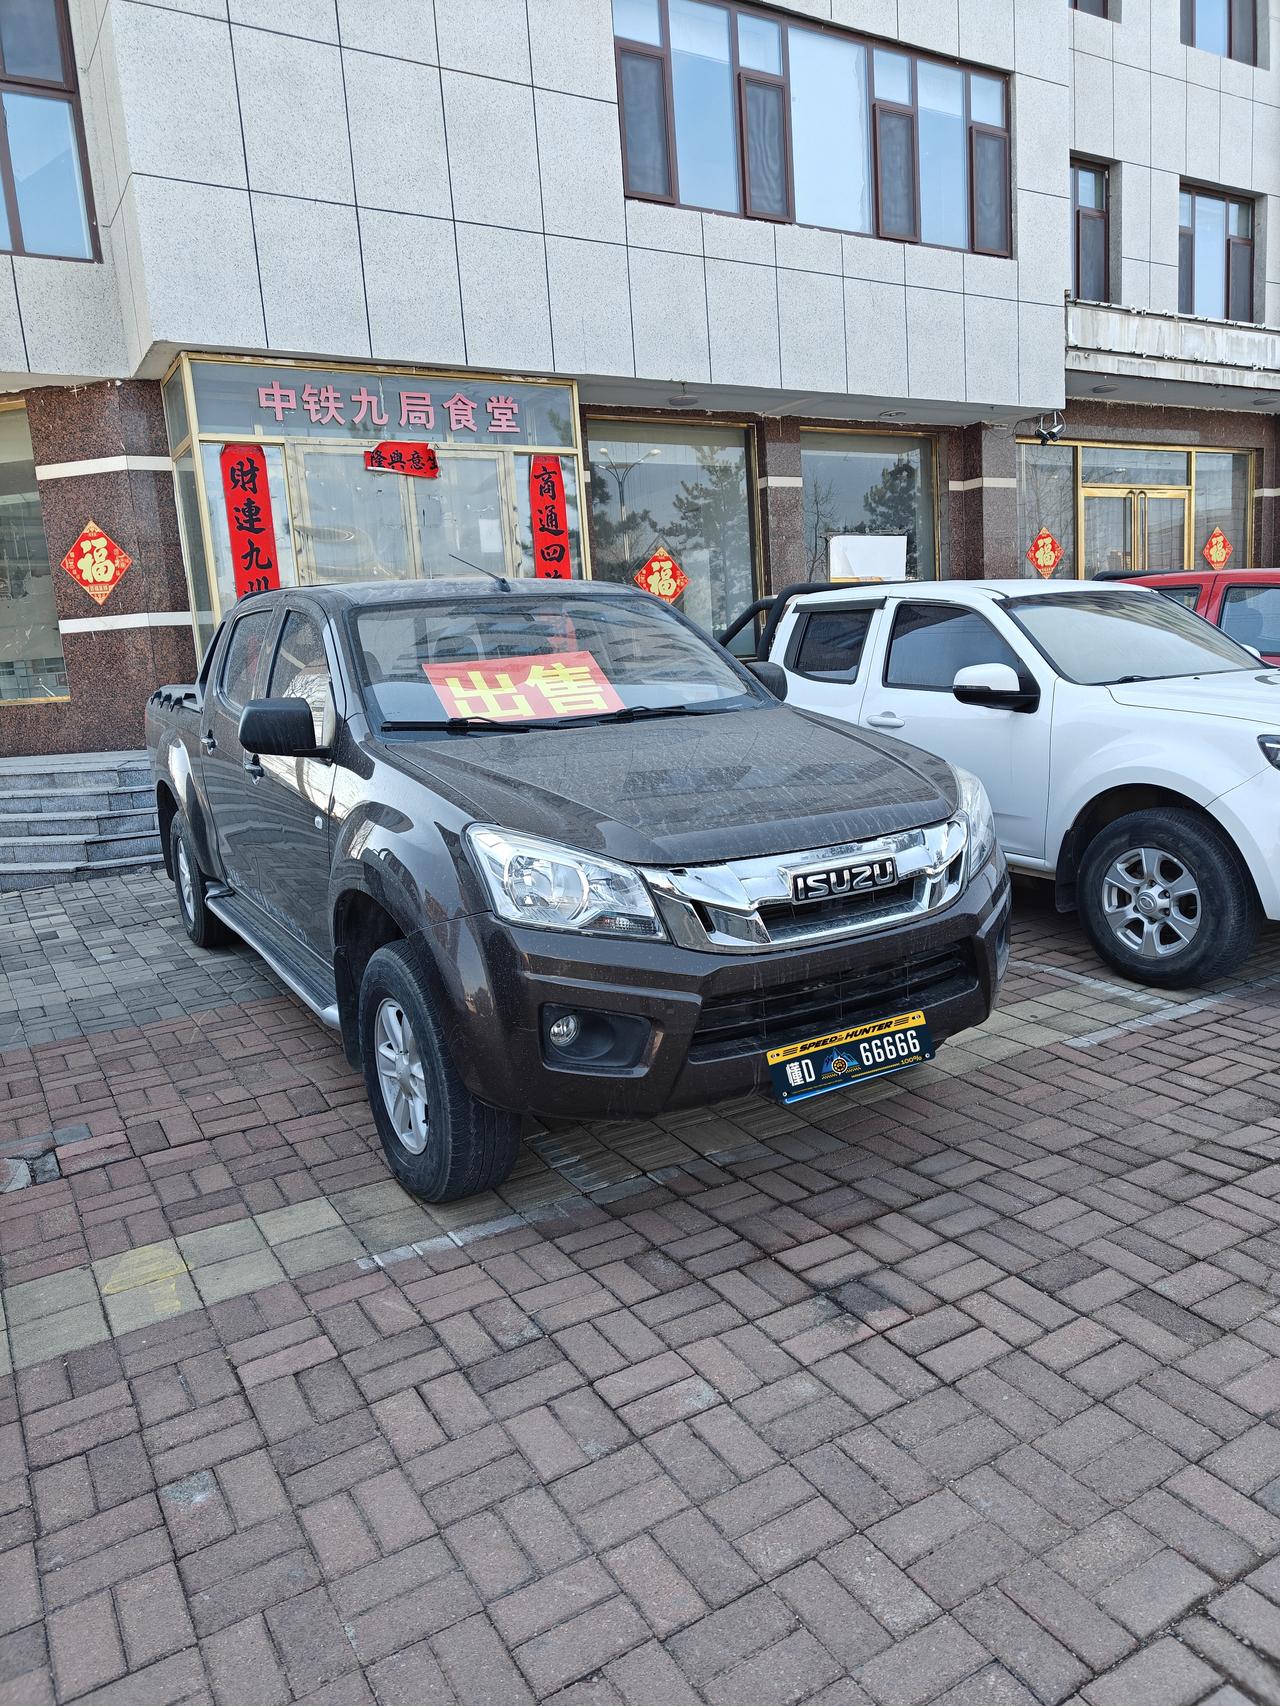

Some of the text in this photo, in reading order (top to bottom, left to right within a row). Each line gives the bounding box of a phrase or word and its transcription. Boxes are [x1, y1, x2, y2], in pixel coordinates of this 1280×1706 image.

[258, 380, 521, 433] 中铁九局食堂
[534, 466, 566, 578] 商通四
[77, 537, 115, 583] 福
[1036, 537, 1055, 566] 福
[1210, 536, 1227, 562] 福
[647, 561, 677, 595] 福
[445, 662, 608, 717] 出售
[797, 861, 894, 900] ISUZU
[799, 1021, 893, 1052] SPEED HUNTER
[860, 1030, 921, 1066] 66666
